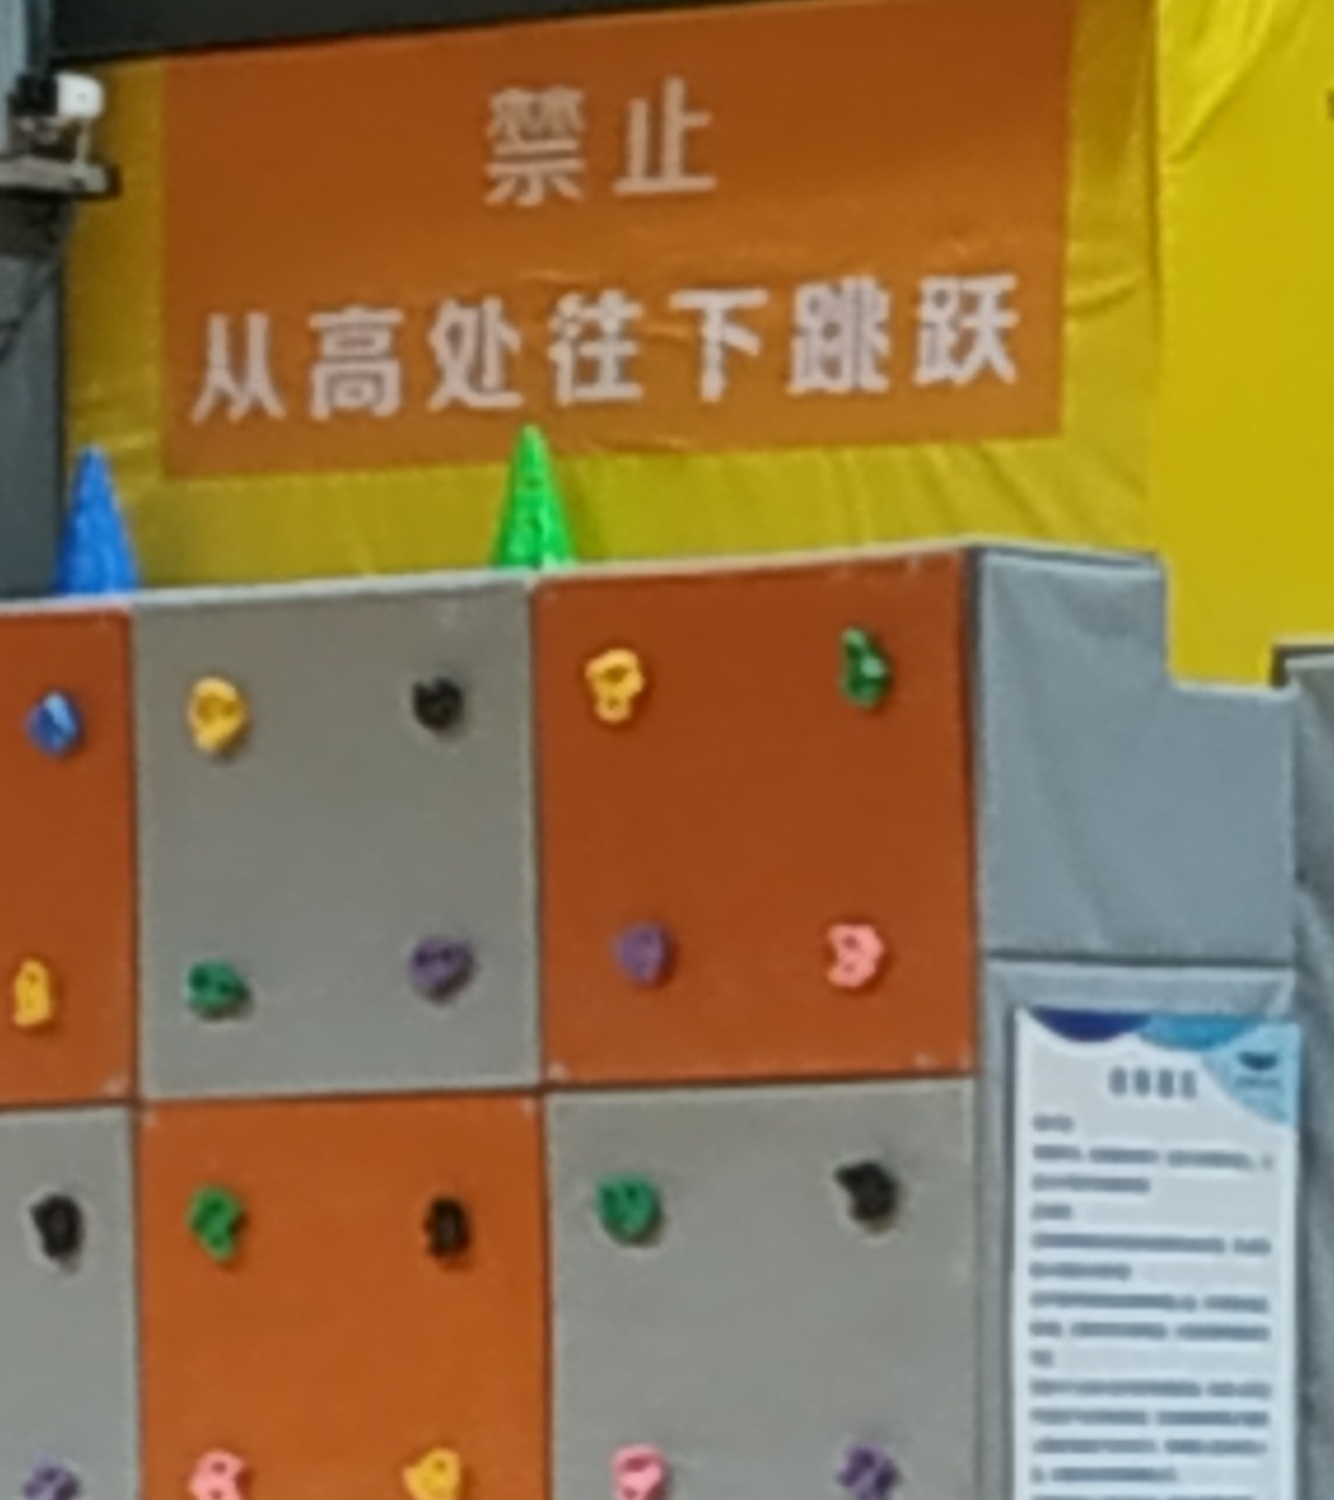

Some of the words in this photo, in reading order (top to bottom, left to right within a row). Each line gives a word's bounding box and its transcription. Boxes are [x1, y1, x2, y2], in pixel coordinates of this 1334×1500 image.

[484, 78, 717, 208] 禁止
[190, 273, 1022, 425] 从高处往下跳跃
